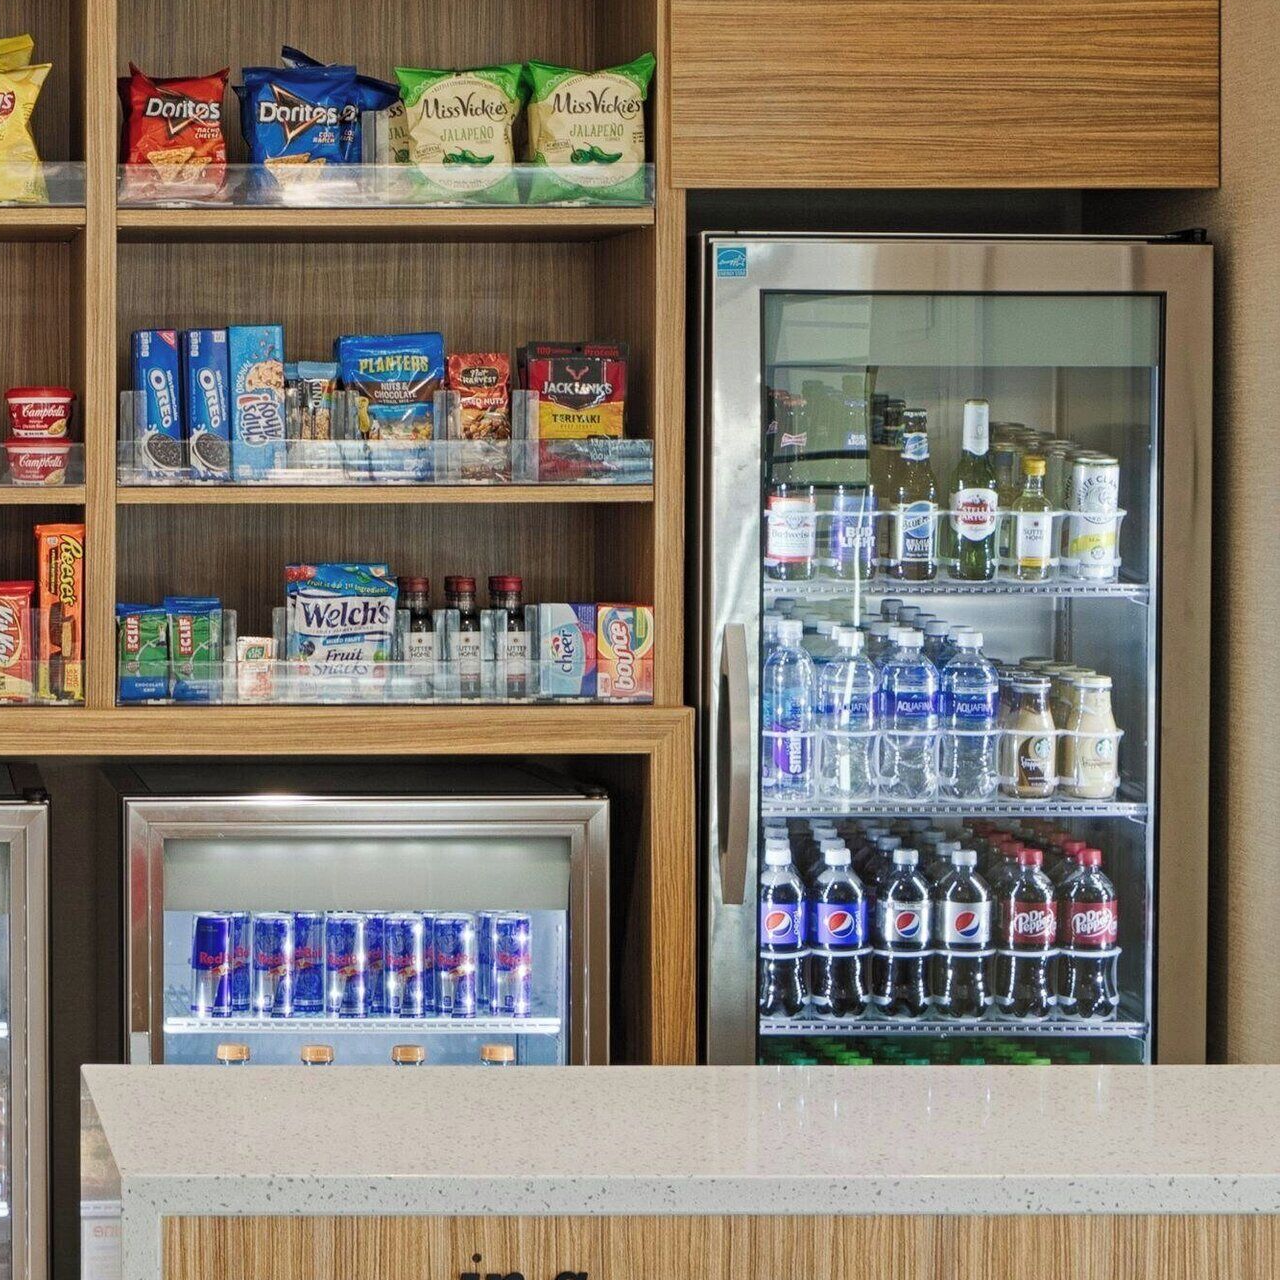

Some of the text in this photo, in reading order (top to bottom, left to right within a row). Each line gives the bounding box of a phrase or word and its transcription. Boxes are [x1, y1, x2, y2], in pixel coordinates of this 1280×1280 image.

[146, 97, 220, 120] Doritos
[259, 101, 337, 123] Doritos
[420, 94, 460, 119] Miss
[552, 93, 590, 115] Miss
[440, 125, 494, 142] JALAPEÑO
[570, 123, 624, 138] JALAPEÑO
[358, 355, 429, 374] PLANTERS
[374, 390, 417, 399] CHOCOLATE
[381, 382, 402, 391] NUTS
[542, 381, 572, 395] JACK
[148, 369, 172, 429] OREO
[198, 369, 221, 429] OREO
[242, 405, 268, 446] Chips
[552, 413, 601, 424] TERIYAKI
[59, 535, 83, 605] Reese's
[300, 600, 391, 629] Welch's
[127, 617, 139, 643] CLIF
[179, 618, 191, 645] CLIF
[326, 648, 364, 662] Fruit
[555, 630, 575, 673] cheer
[611, 621, 635, 690] bounce
[896, 700, 934, 712] AQUAFINA
[1029, 910, 1044, 921] Dr
